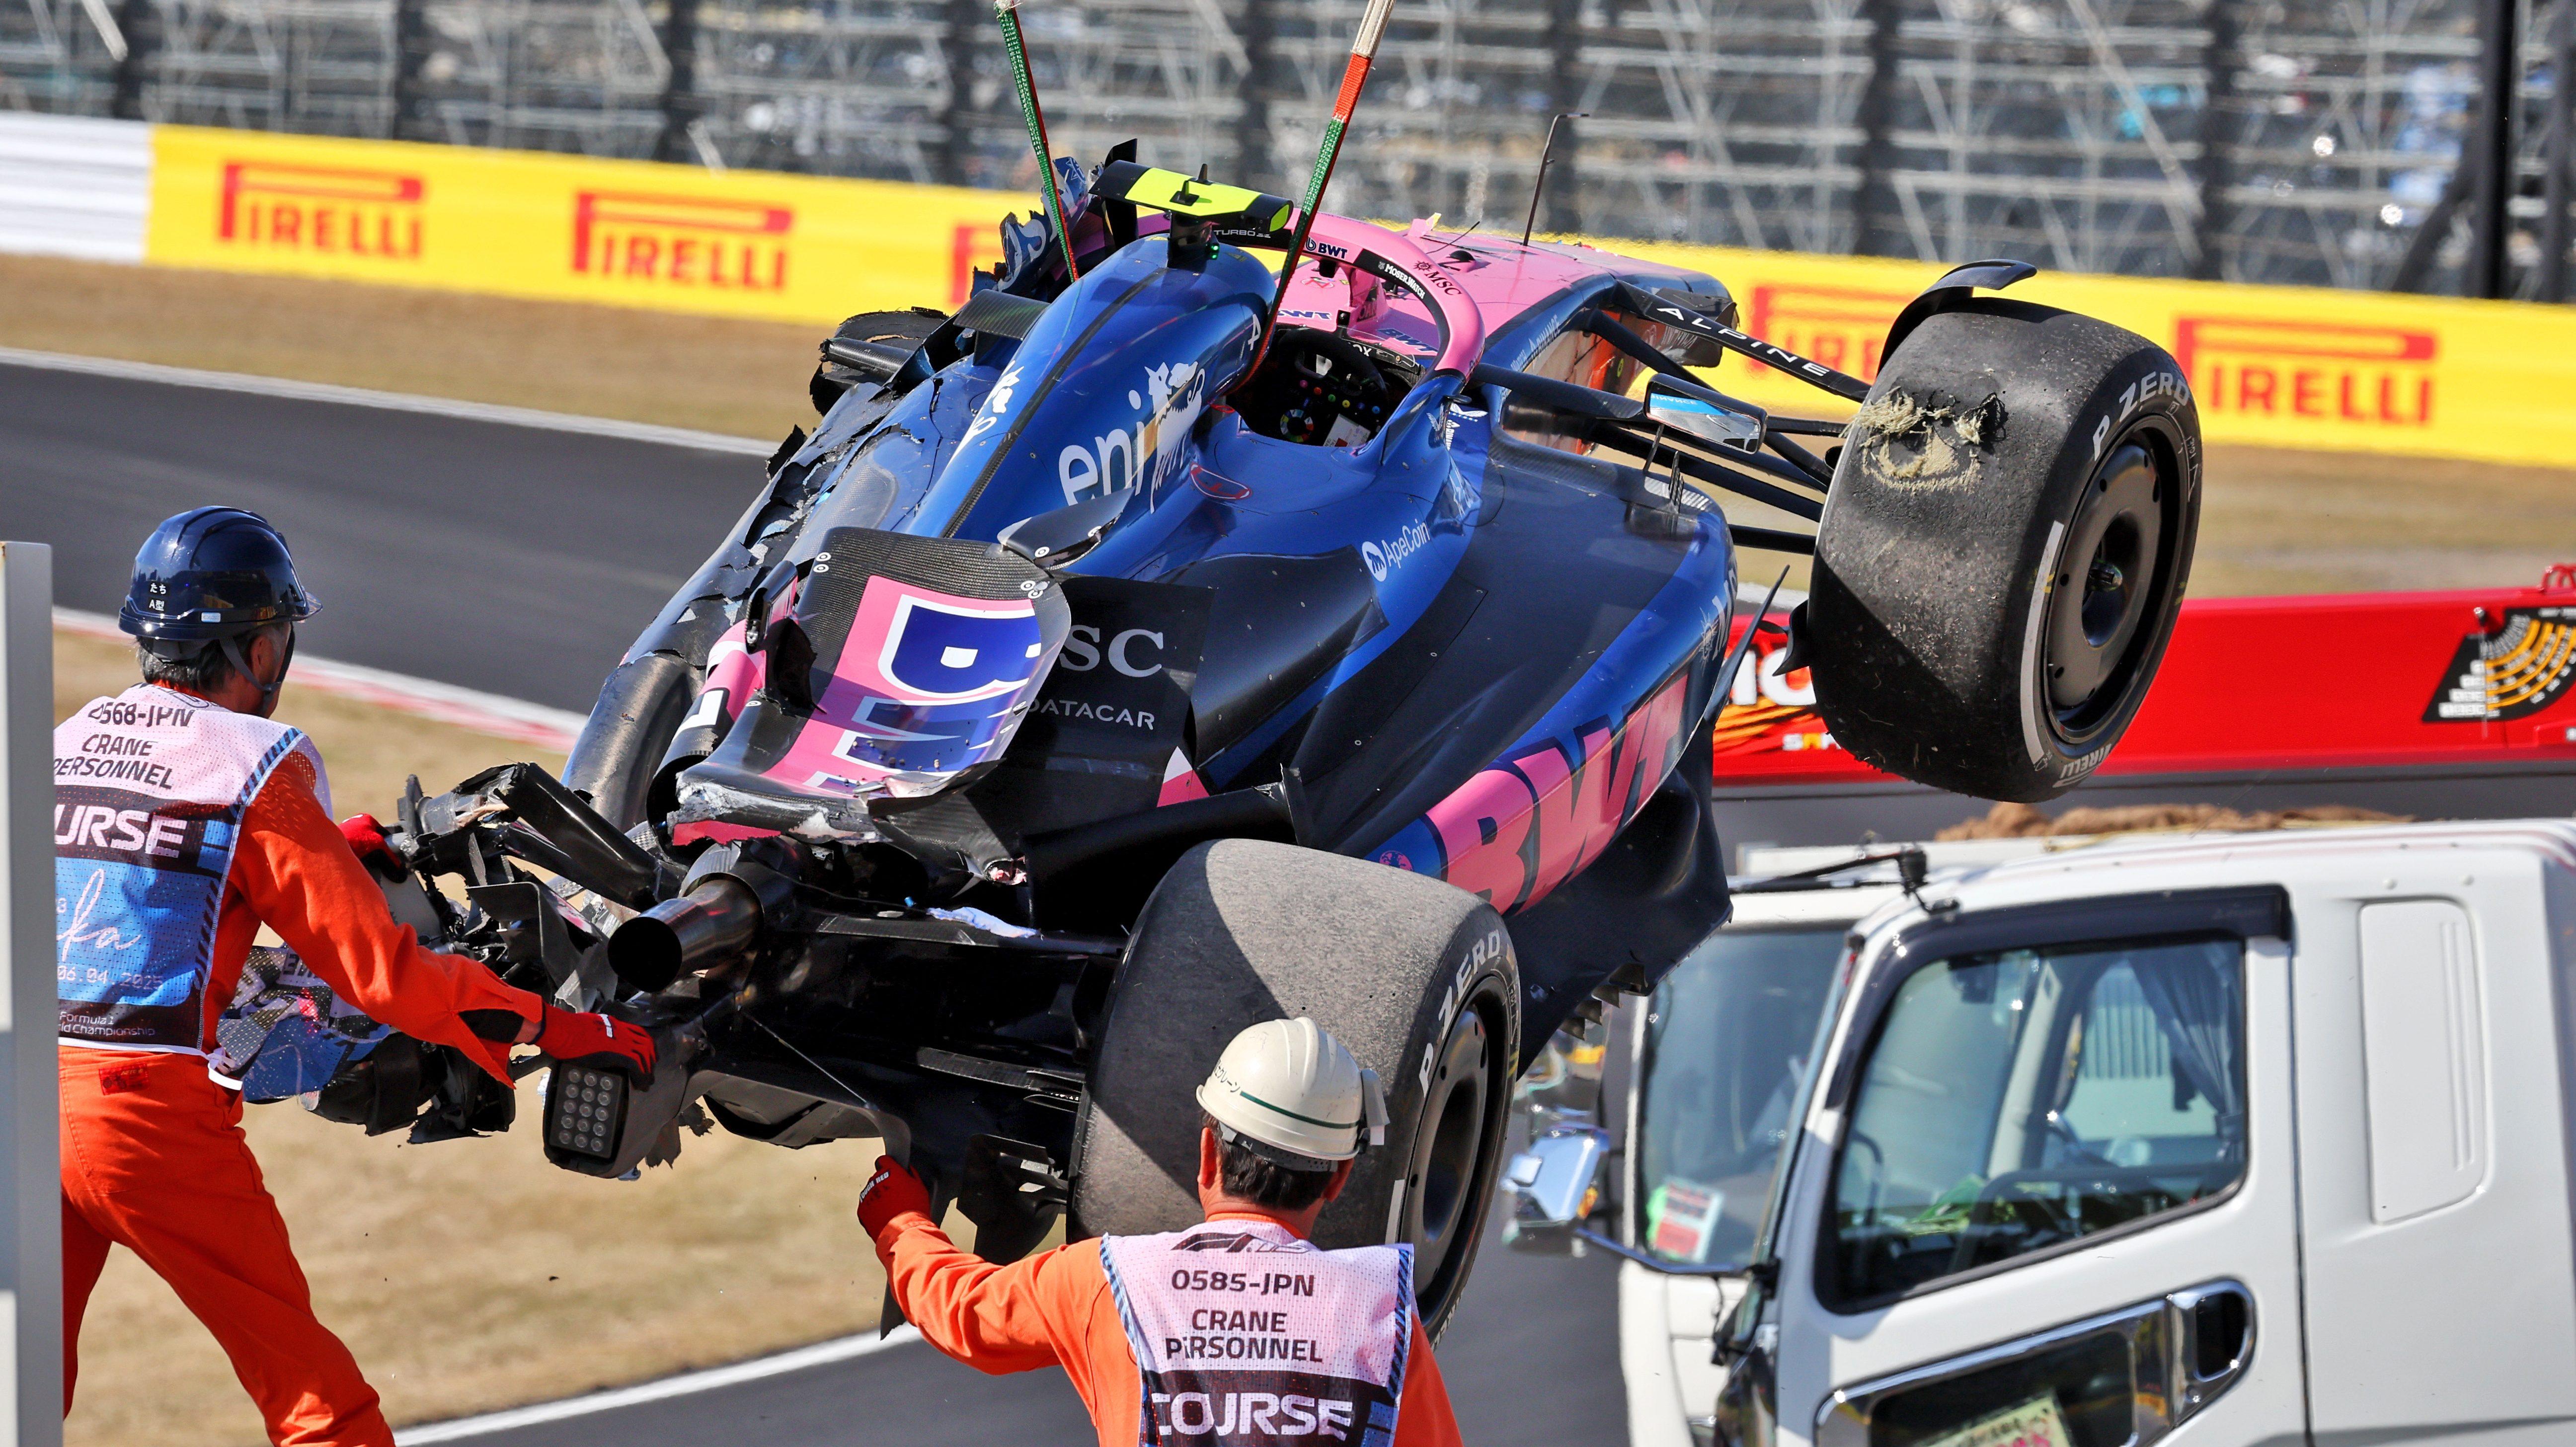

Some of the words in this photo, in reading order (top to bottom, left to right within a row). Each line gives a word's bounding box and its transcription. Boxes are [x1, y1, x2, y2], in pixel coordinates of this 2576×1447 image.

[219, 161, 424, 259] PIRELLI
[570, 190, 794, 291] PIRELLI
[1318, 242, 1348, 260] BWT
[1424, 271, 1462, 296] MSC
[1277, 309, 1331, 320] WT
[1657, 307, 1830, 377] ALPINE
[2175, 317, 2438, 425] PIRELLI
[2093, 414, 2110, 462] P
[2118, 371, 2189, 422] ZERO
[1058, 389, 1146, 506] eni
[1381, 518, 1430, 569] ApeCoin
[1059, 624, 1164, 677] SC
[81, 733, 159, 756] CRANE
[1426, 673, 1688, 917] BWT
[54, 804, 188, 859] URSE
[1438, 929, 1501, 1042] ZERO
[60, 1011, 106, 1025] Formula
[73, 1024, 156, 1037] Championship
[875, 1171, 889, 1184] RED
[1171, 1269, 1315, 1297] 0585-JPN
[1192, 1309, 1288, 1333] CRANE
